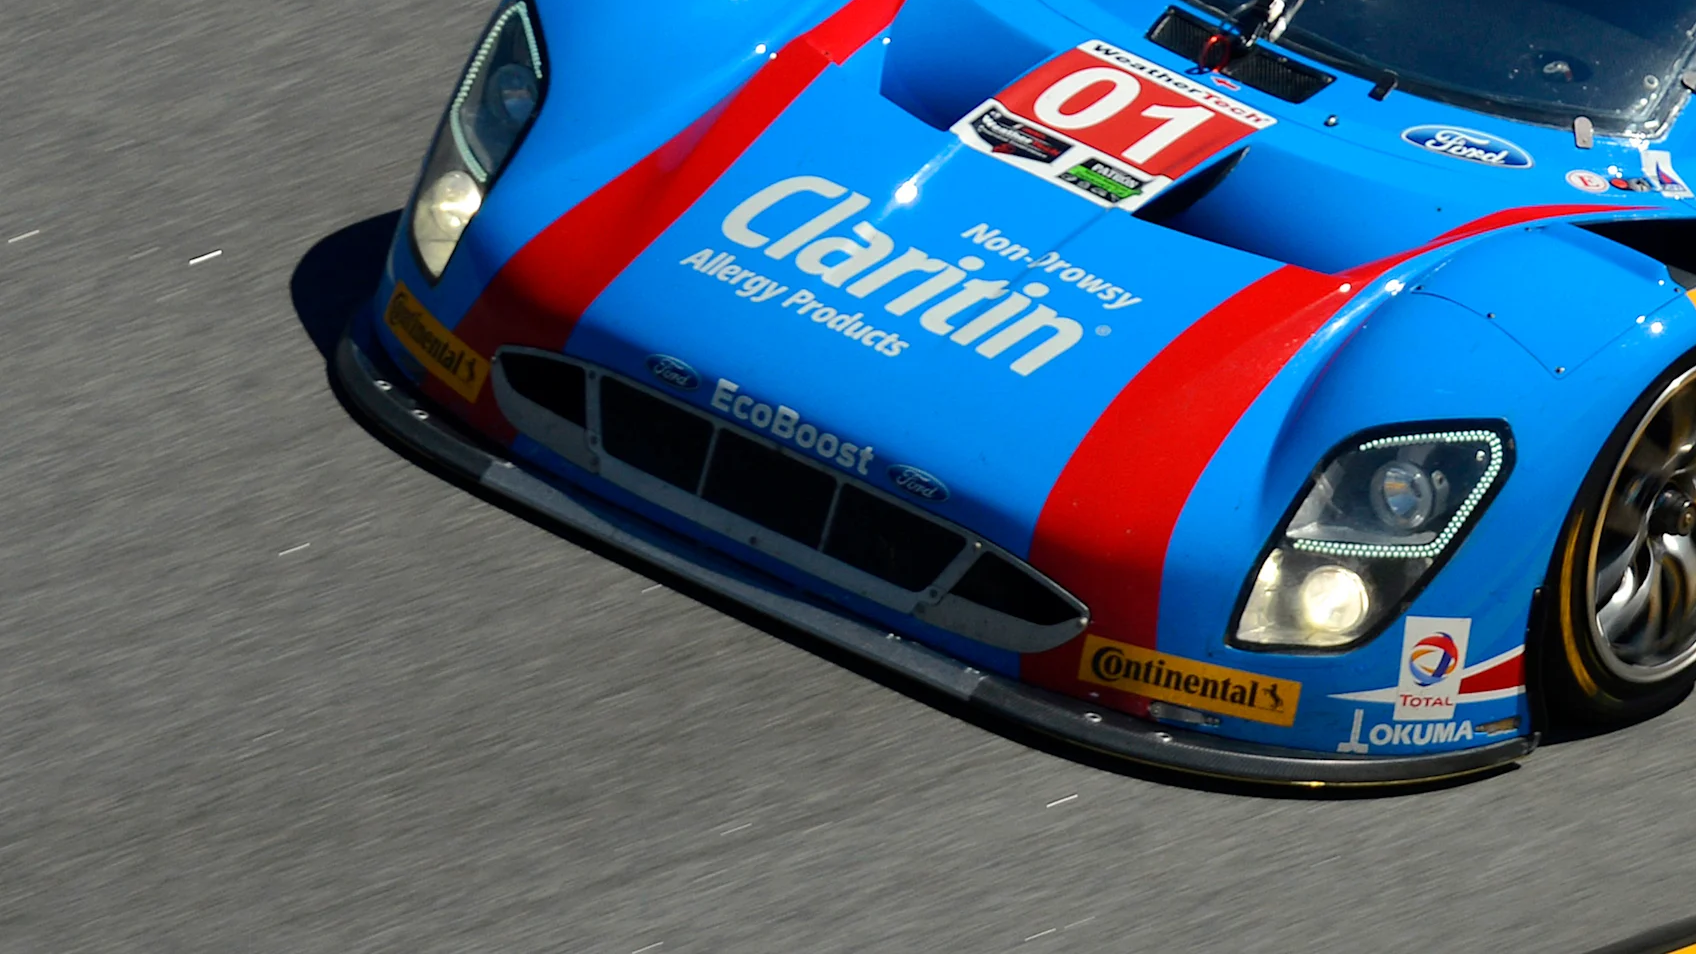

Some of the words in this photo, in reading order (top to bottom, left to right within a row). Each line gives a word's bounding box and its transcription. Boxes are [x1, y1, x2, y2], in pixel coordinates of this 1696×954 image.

[1033, 67, 1216, 165] 01
[1094, 44, 1266, 124] WeatherTech
[1425, 129, 1506, 166] Ford
[679, 248, 784, 303] Allergy
[781, 288, 909, 357] Products
[721, 175, 1084, 377] Claritin
[710, 378, 875, 475] EcoBoost
[894, 466, 940, 499] Ford
[1091, 646, 1259, 708] Continental
[1400, 694, 1454, 708] TOTAL
[1368, 719, 1474, 746] OKUMA
